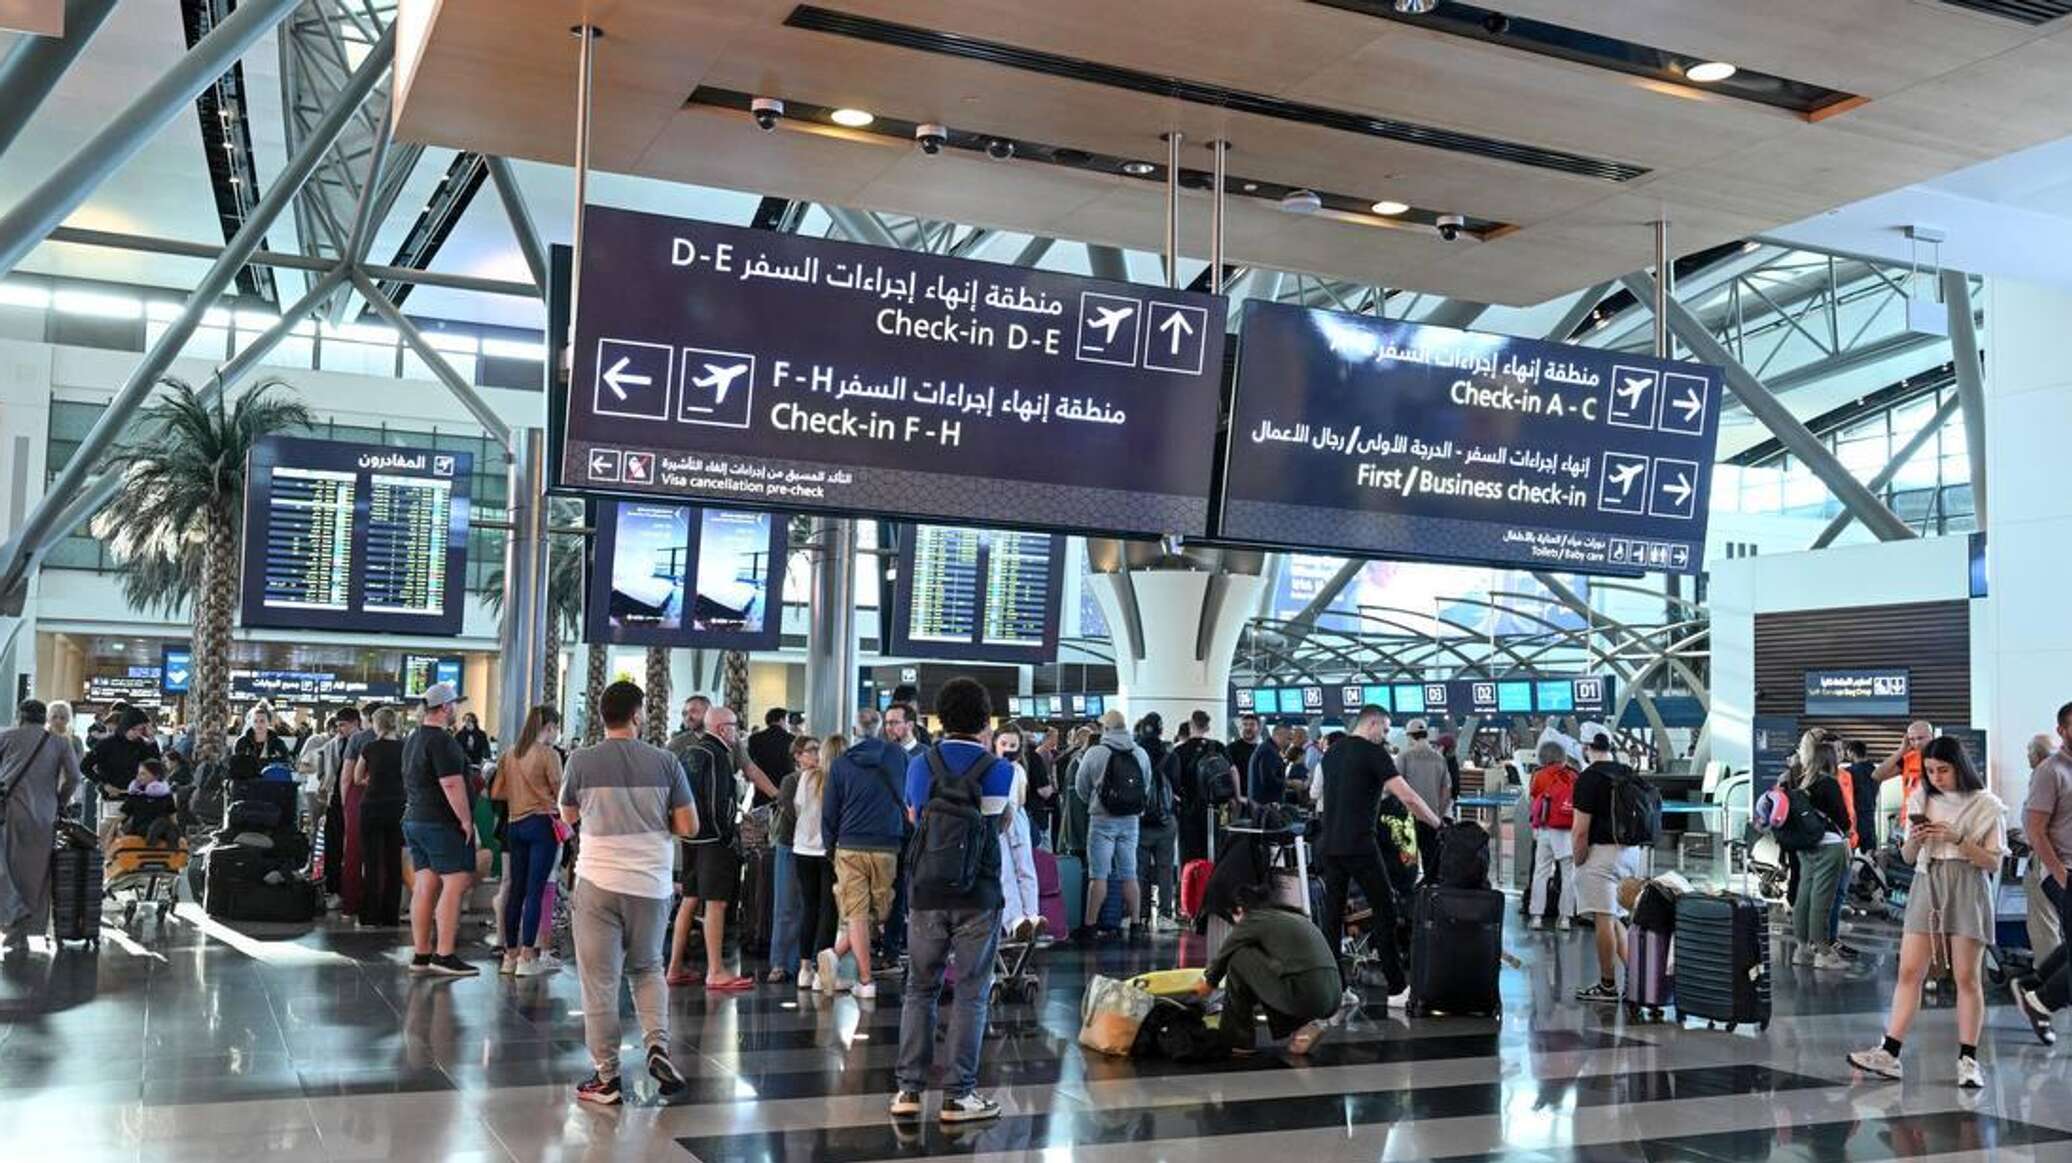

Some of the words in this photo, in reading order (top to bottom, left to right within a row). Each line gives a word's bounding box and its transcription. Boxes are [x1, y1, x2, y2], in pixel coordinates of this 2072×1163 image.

[740, 254, 819, 283] السفر
[826, 263, 916, 303] إجراءات
[925, 275, 978, 312] إنهاء
[985, 284, 1063, 315] منطقة
[876, 309, 994, 346] Check-in
[1376, 341, 1430, 363] السفر
[1502, 358, 1540, 384] إنهاء
[1544, 363, 1600, 387] منطقة
[835, 374, 907, 400] السفر
[913, 381, 994, 417] إجراءات
[1450, 380, 1541, 414] Check-in
[1001, 389, 1050, 422] إنهاء
[1055, 397, 1126, 424] منطقة
[770, 402, 895, 440] Check-in
[358, 453, 426, 468] المغادرون
[1410, 439, 1452, 461] الدرجة
[1465, 446, 1508, 464] السفر
[1509, 450, 1558, 475] إجراءات
[767, 470, 784, 480] من
[1561, 455, 1591, 478] إنهاء
[661, 474, 687, 487] Visa
[690, 477, 764, 493] cancellation
[766, 483, 825, 498] pre-check
[1508, 478, 1587, 507] check-in
[1428, 688, 1443, 701] D3
[1477, 686, 1492, 700] D2
[1580, 684, 1596, 698] D1
